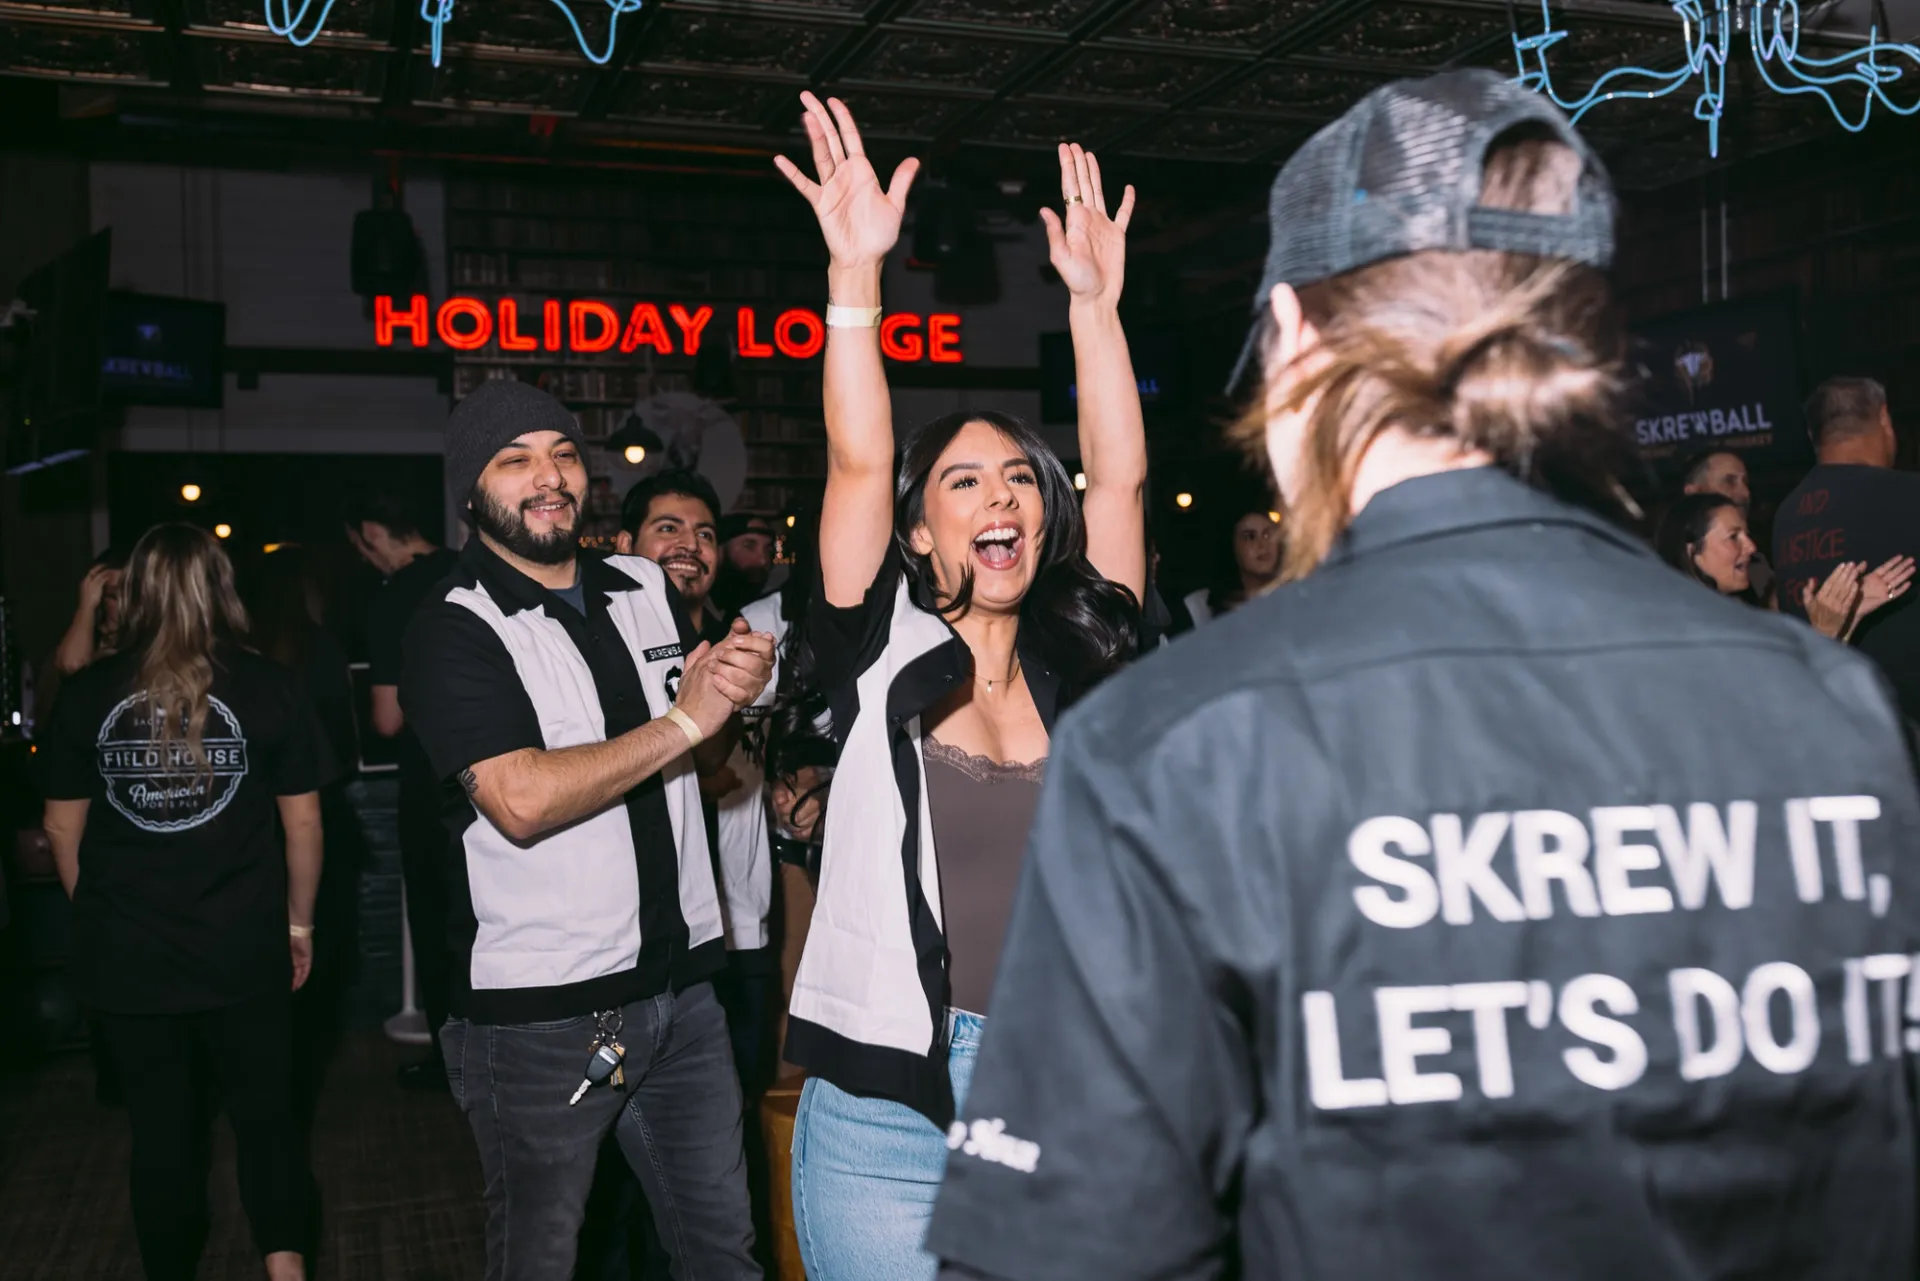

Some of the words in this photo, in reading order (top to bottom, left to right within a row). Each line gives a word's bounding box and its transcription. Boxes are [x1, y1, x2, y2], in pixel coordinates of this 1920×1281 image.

[375, 295, 712, 356] HOLIDAY
[737, 307, 963, 363] LOGE
[1636, 401, 1773, 446] SKREWBALL
[104, 751, 158, 767] FIELD
[1348, 800, 1757, 928] SKREW
[1786, 795, 1890, 917] IT,
[1303, 974, 1648, 1109] LET'S
[1669, 961, 1820, 1081] DO
